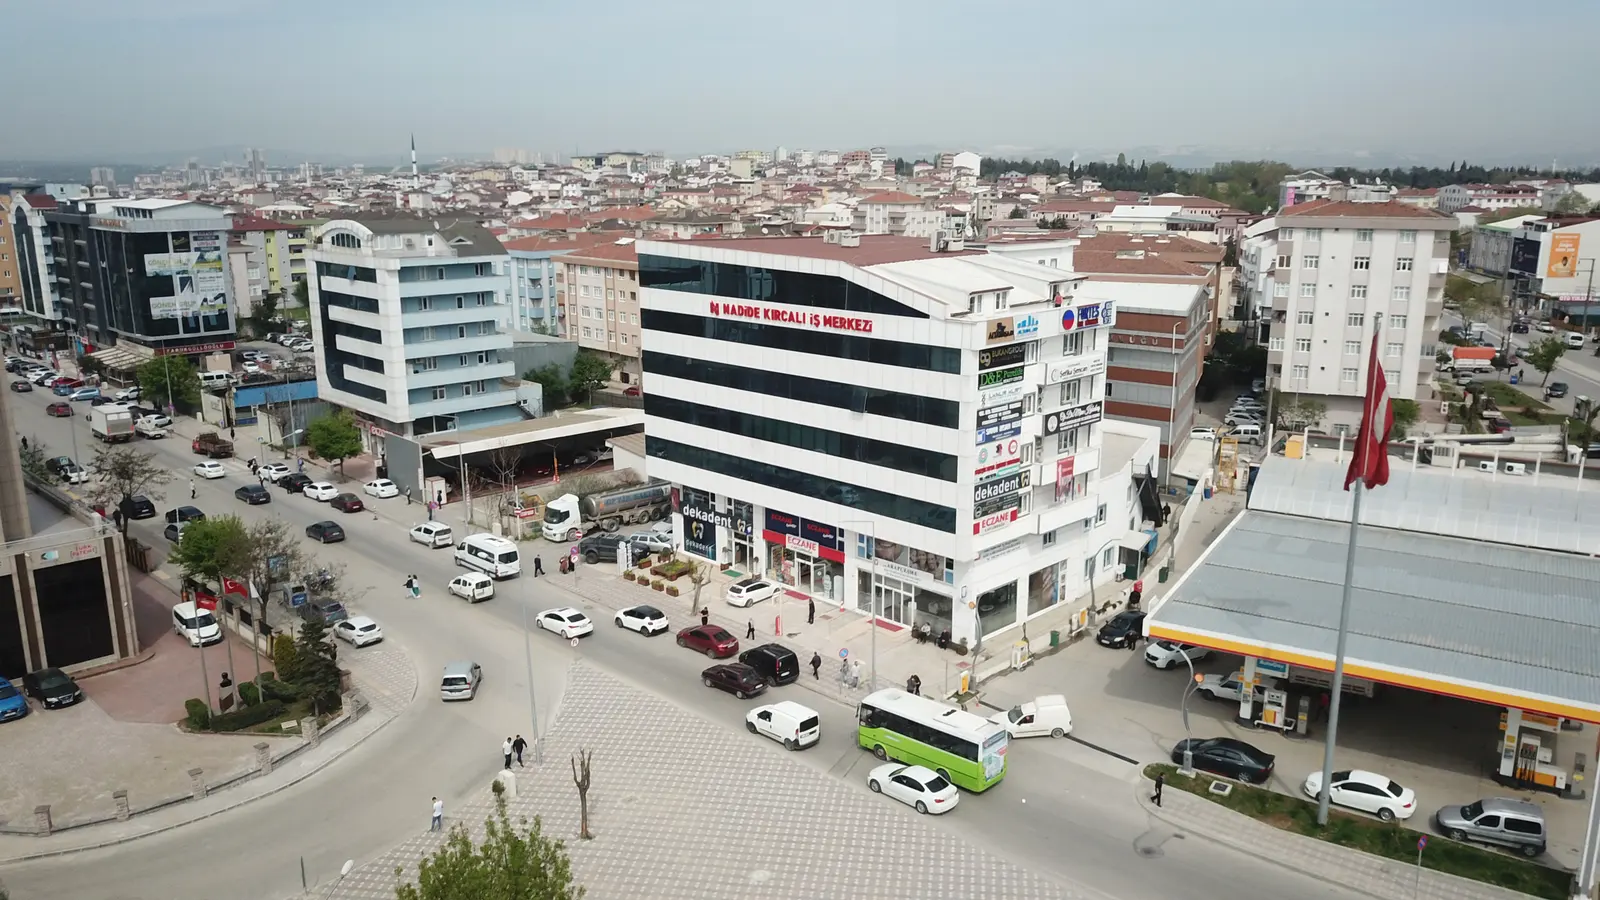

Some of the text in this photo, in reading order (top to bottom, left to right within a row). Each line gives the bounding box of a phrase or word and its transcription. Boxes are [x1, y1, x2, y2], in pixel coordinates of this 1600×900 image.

[763, 308, 806, 325] KIRCALI
[975, 476, 1020, 501] dekadent
[683, 504, 732, 528] dekadent
[982, 511, 1009, 529] ECZANE
[787, 536, 817, 551] ECZANE
